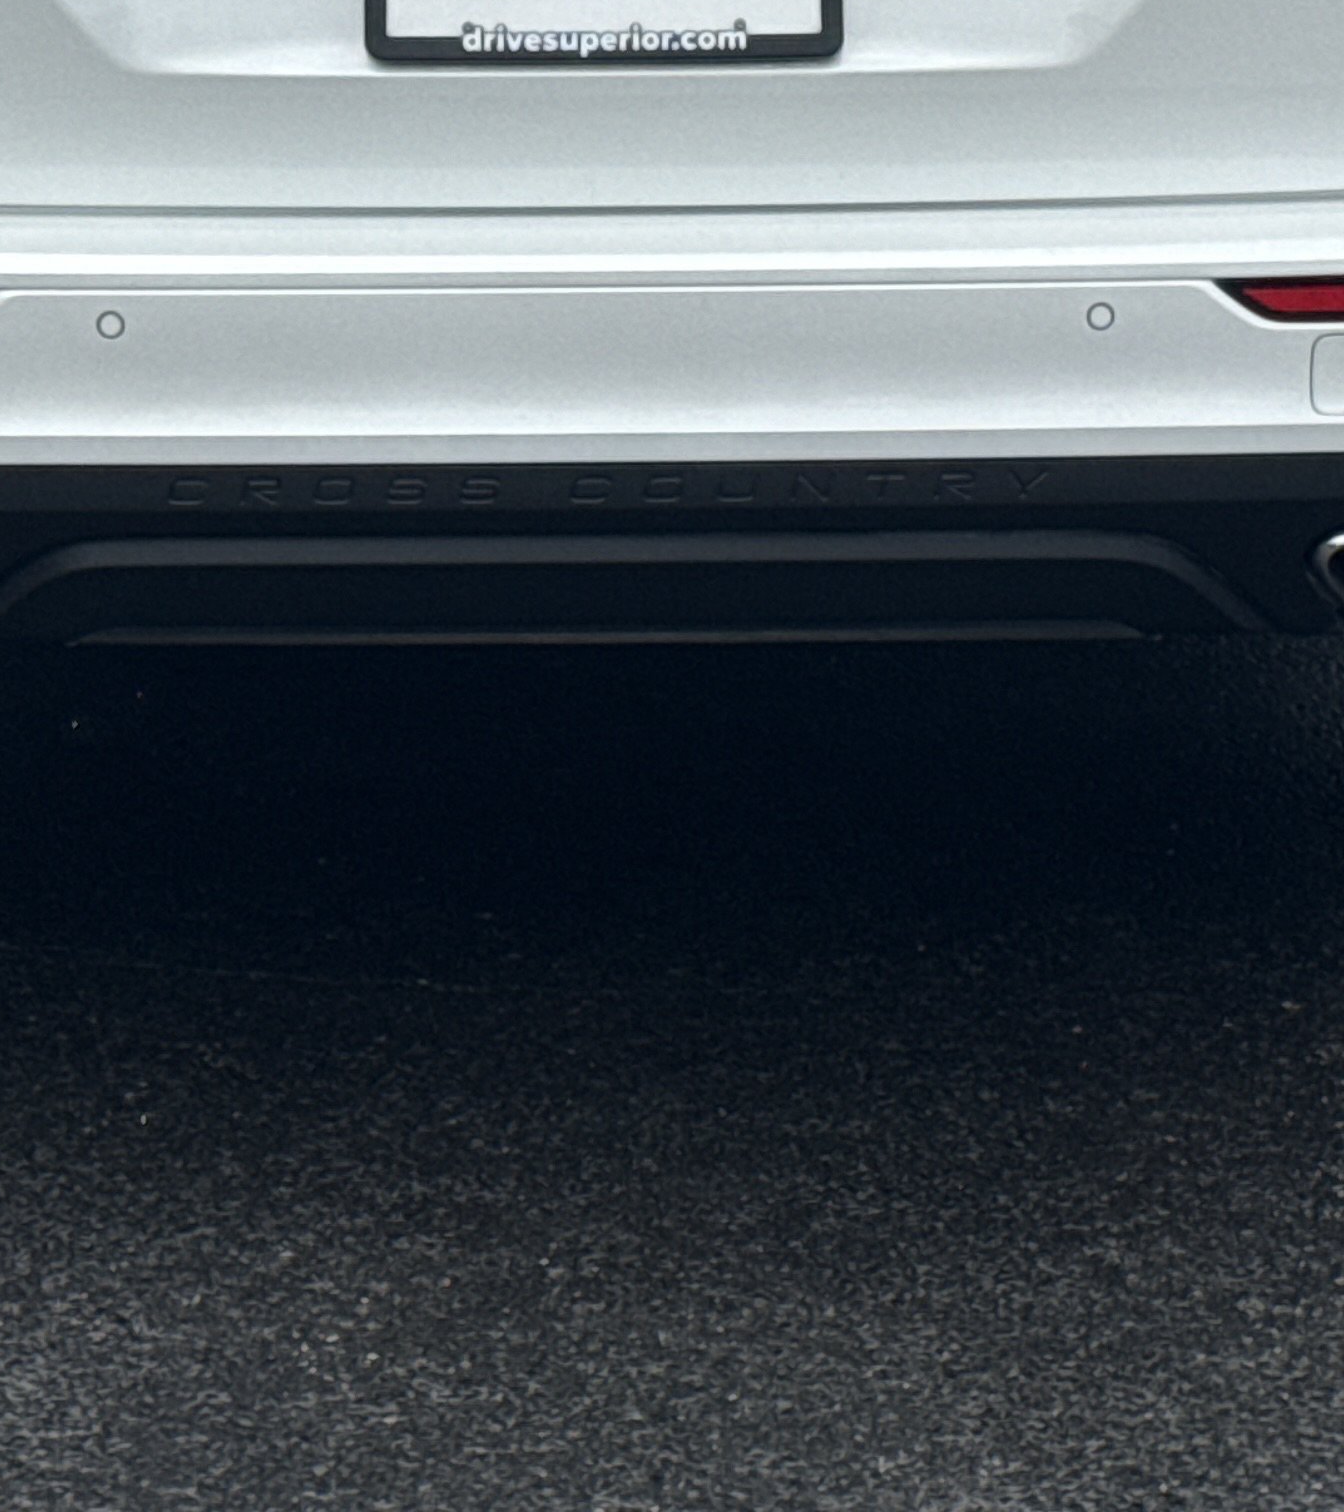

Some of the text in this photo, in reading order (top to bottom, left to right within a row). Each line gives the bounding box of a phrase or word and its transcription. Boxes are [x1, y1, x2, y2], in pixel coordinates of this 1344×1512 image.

[462, 24, 747, 58] drivesuperior.com
[168, 470, 1050, 506] CROSS COUNTRY
